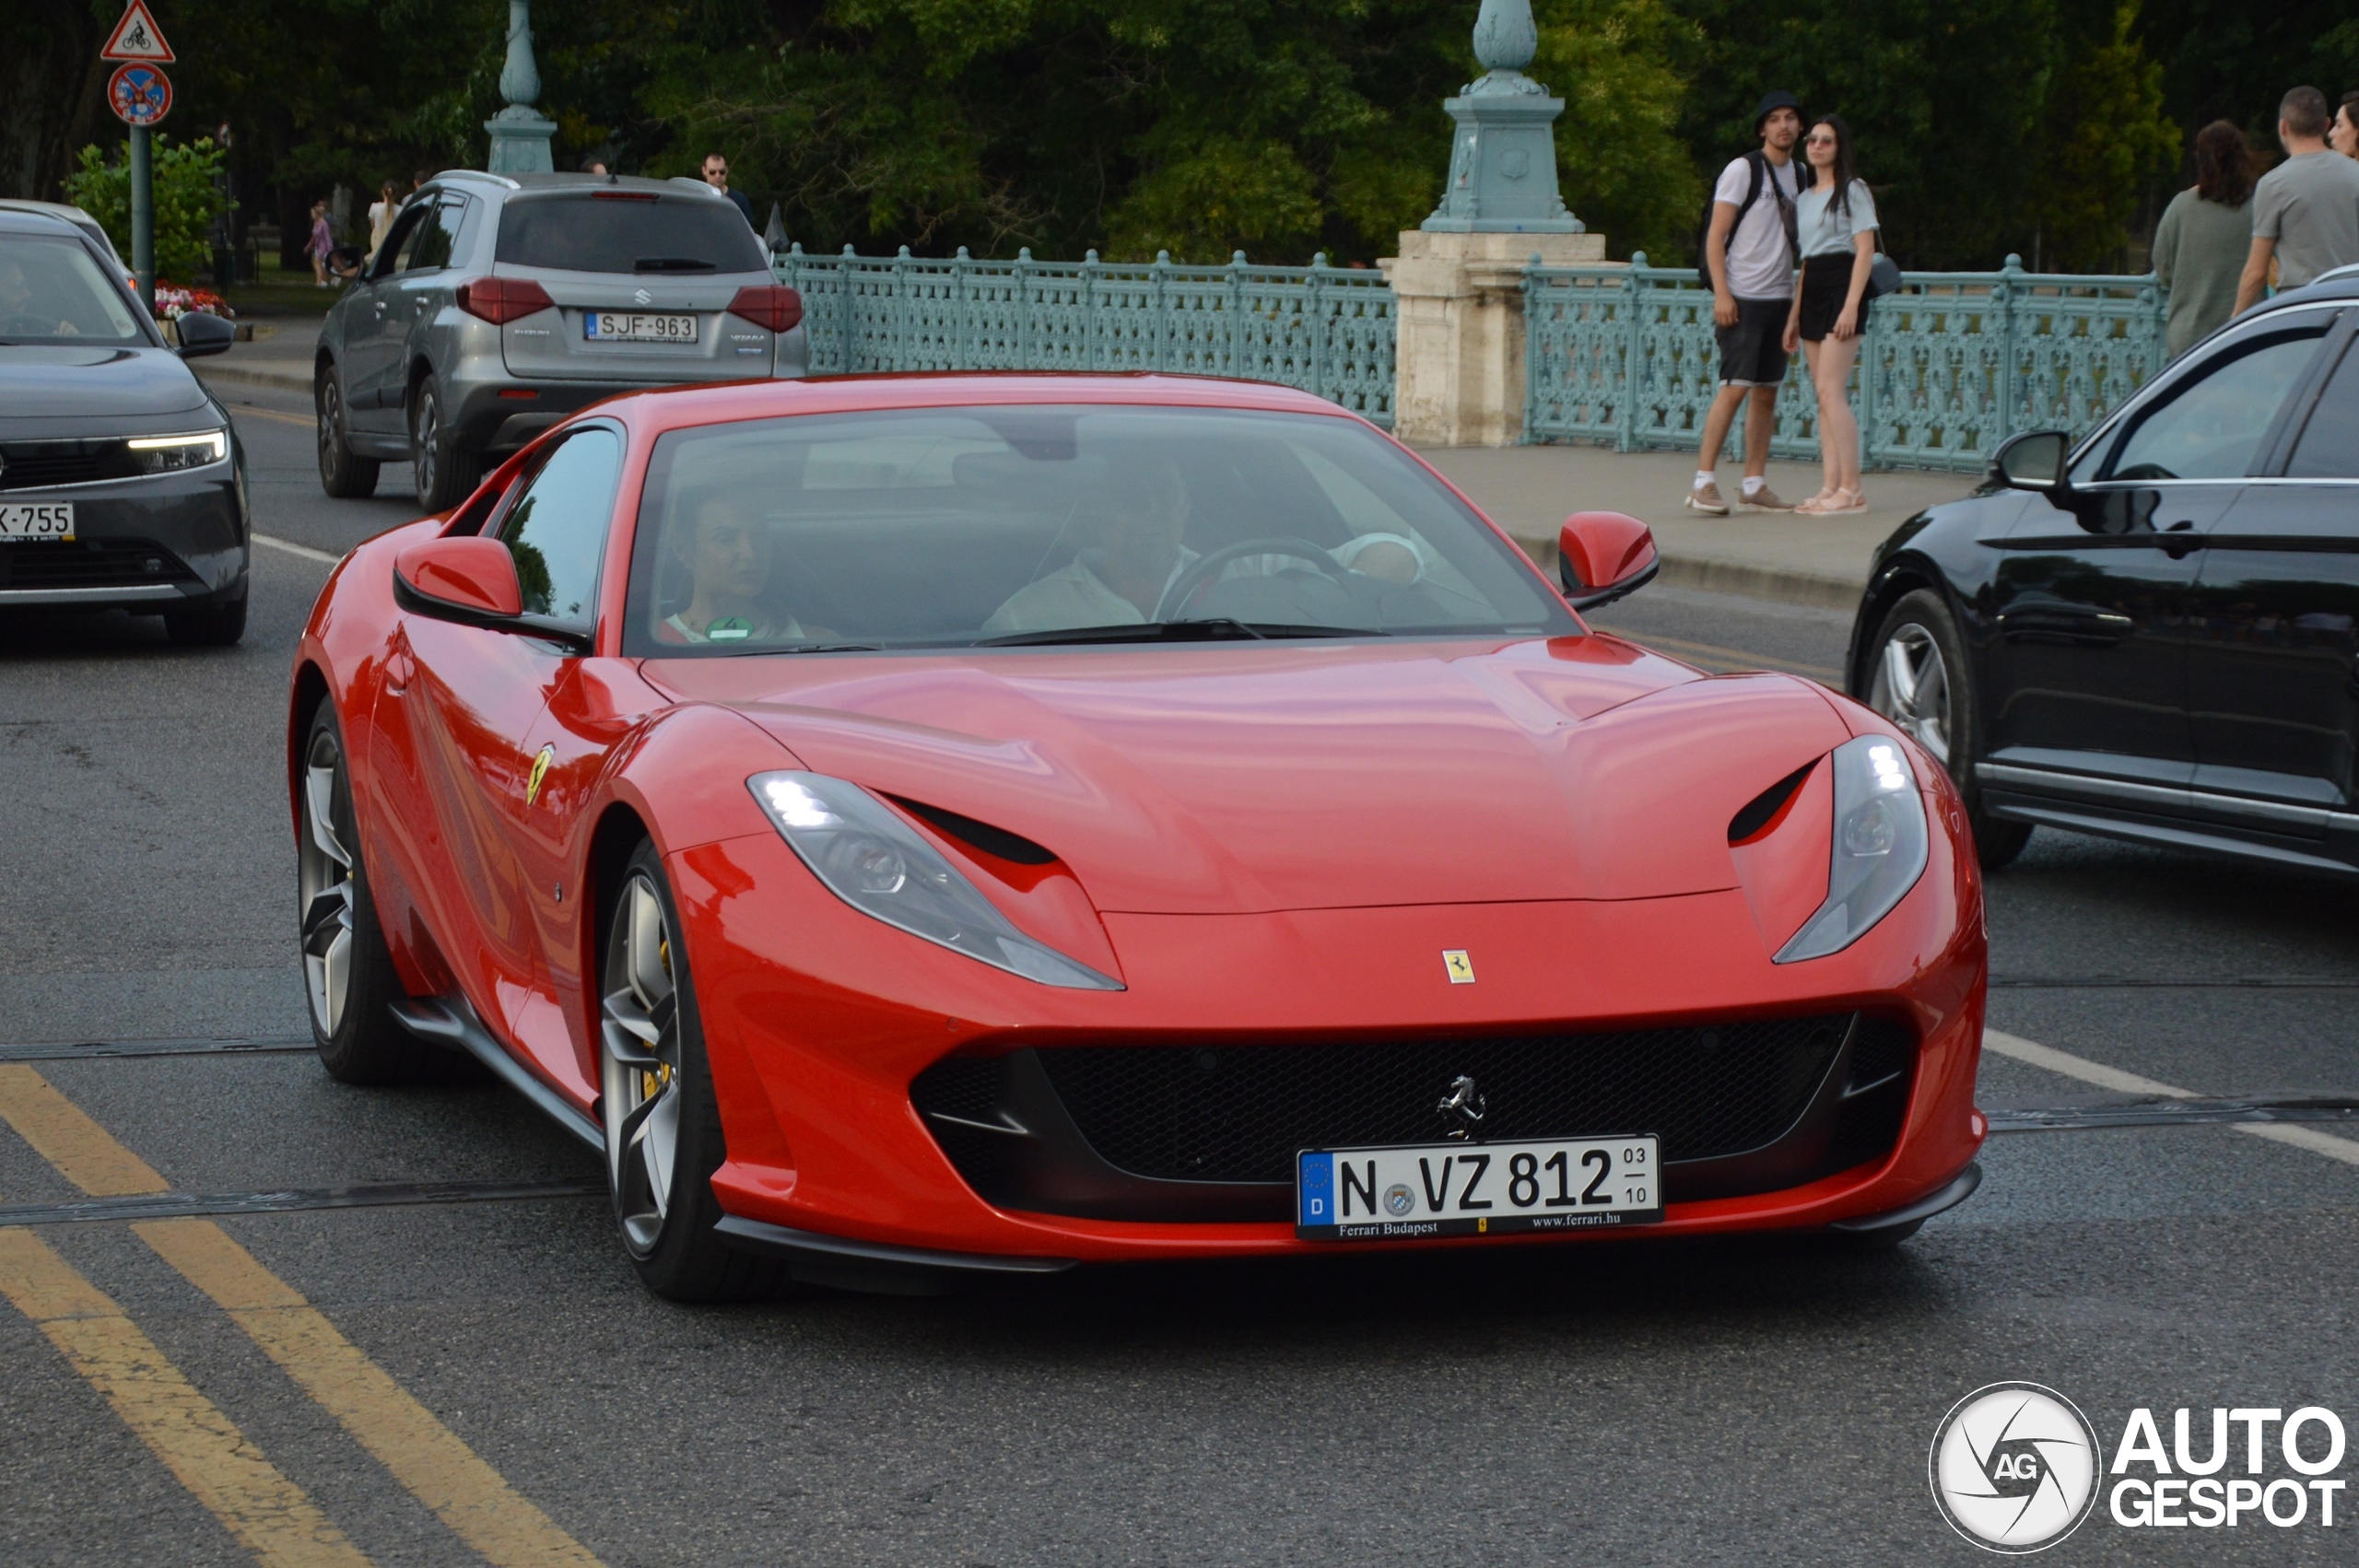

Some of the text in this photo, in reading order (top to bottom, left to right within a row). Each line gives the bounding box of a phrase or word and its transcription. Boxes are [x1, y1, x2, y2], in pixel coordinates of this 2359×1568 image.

[602, 315, 691, 336] SJF-963
[1624, 1147, 1646, 1164] 03
[1341, 1160, 1377, 1216] N
[1419, 1153, 1493, 1212] VZ
[1508, 1149, 1613, 1208] 812
[1625, 1188, 1647, 1204] 10
[1311, 1198, 1323, 1215] D
[1532, 1211, 1621, 1227] www.ferrari.hu
[1339, 1222, 1438, 1236] Ferrari Budapest
